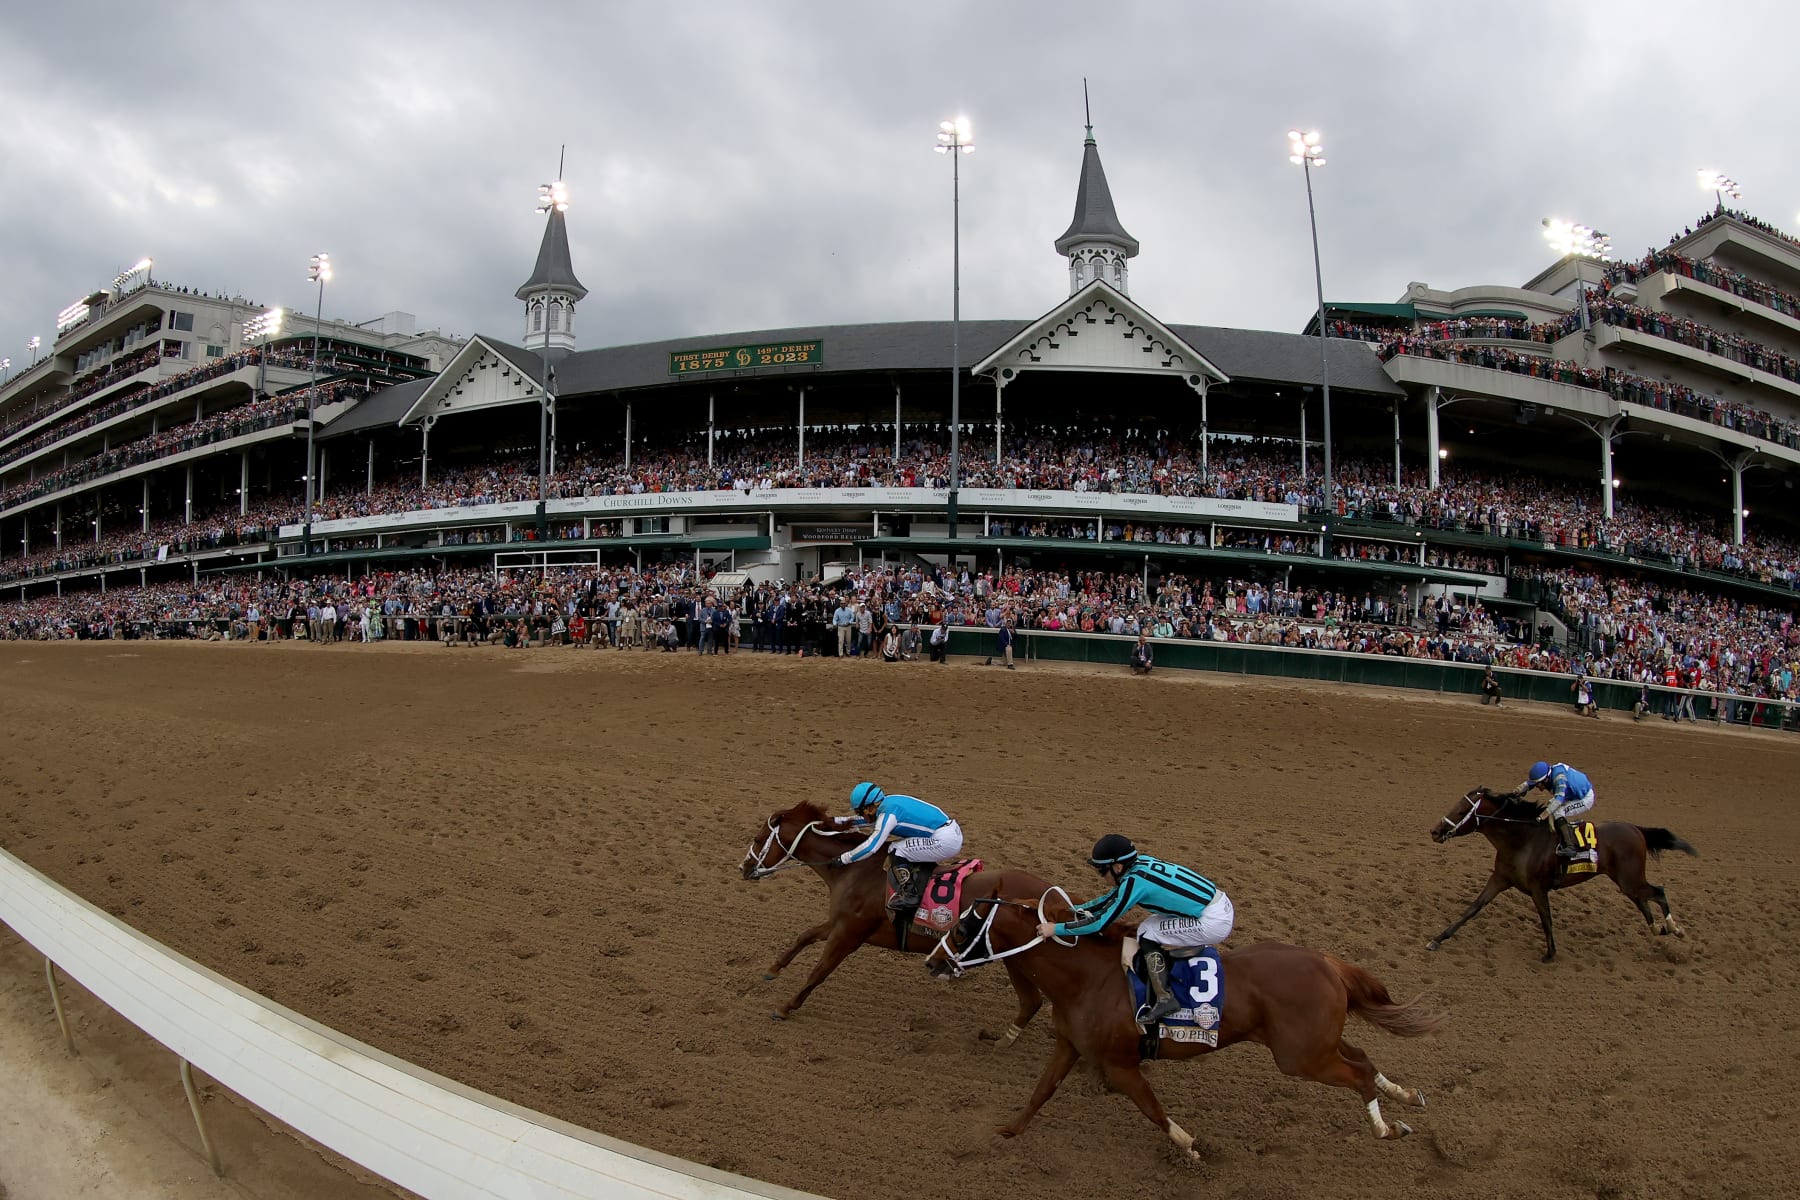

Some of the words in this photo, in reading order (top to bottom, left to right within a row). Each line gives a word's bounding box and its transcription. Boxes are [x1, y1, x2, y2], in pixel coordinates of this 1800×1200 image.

[781, 344, 816, 353] DERBY
[674, 354, 700, 362] FIRST
[702, 351, 730, 359] DERBY
[760, 352, 808, 364] 2023
[679, 358, 724, 371] 1875
[603, 498, 653, 508] CHURCHILL
[658, 495, 693, 505] DOWNS
[1575, 822, 1597, 848] 14
[930, 871, 958, 904] 8
[1160, 919, 1177, 931] JEFF
[1188, 956, 1218, 1002] 3
[1160, 1026, 1185, 1040] TWO
